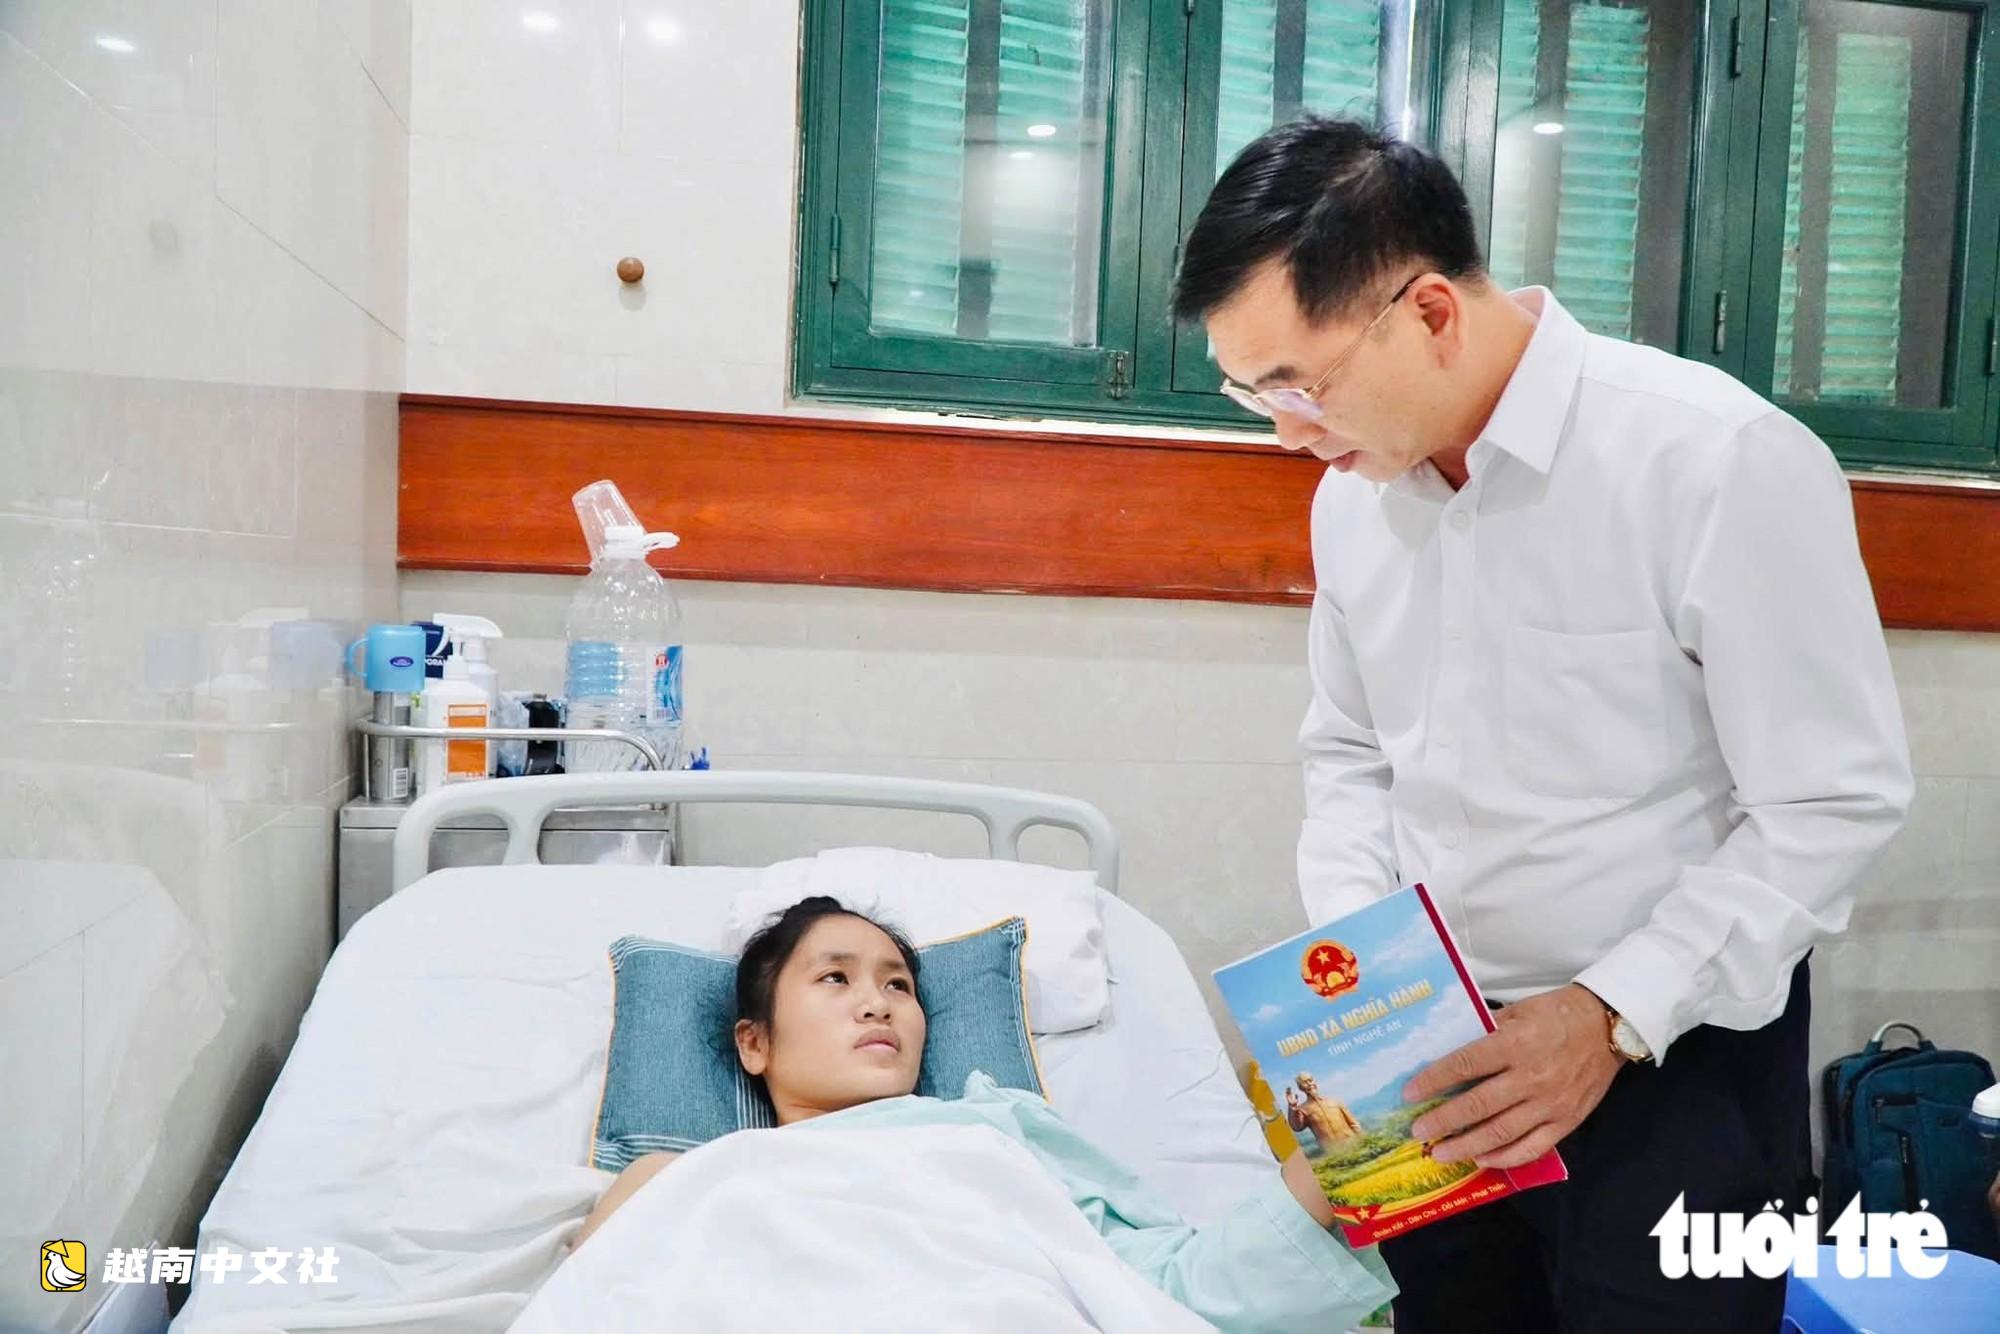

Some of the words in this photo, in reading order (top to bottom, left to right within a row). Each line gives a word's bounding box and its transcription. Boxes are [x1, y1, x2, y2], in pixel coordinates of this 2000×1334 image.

[1276, 1028, 1319, 1057] UBND
[1317, 1016, 1344, 1040] XÃ
[1340, 993, 1390, 1030] NGHĨA
[1388, 977, 1434, 1010] HÀNH
[1385, 1018, 1403, 1034] AN
